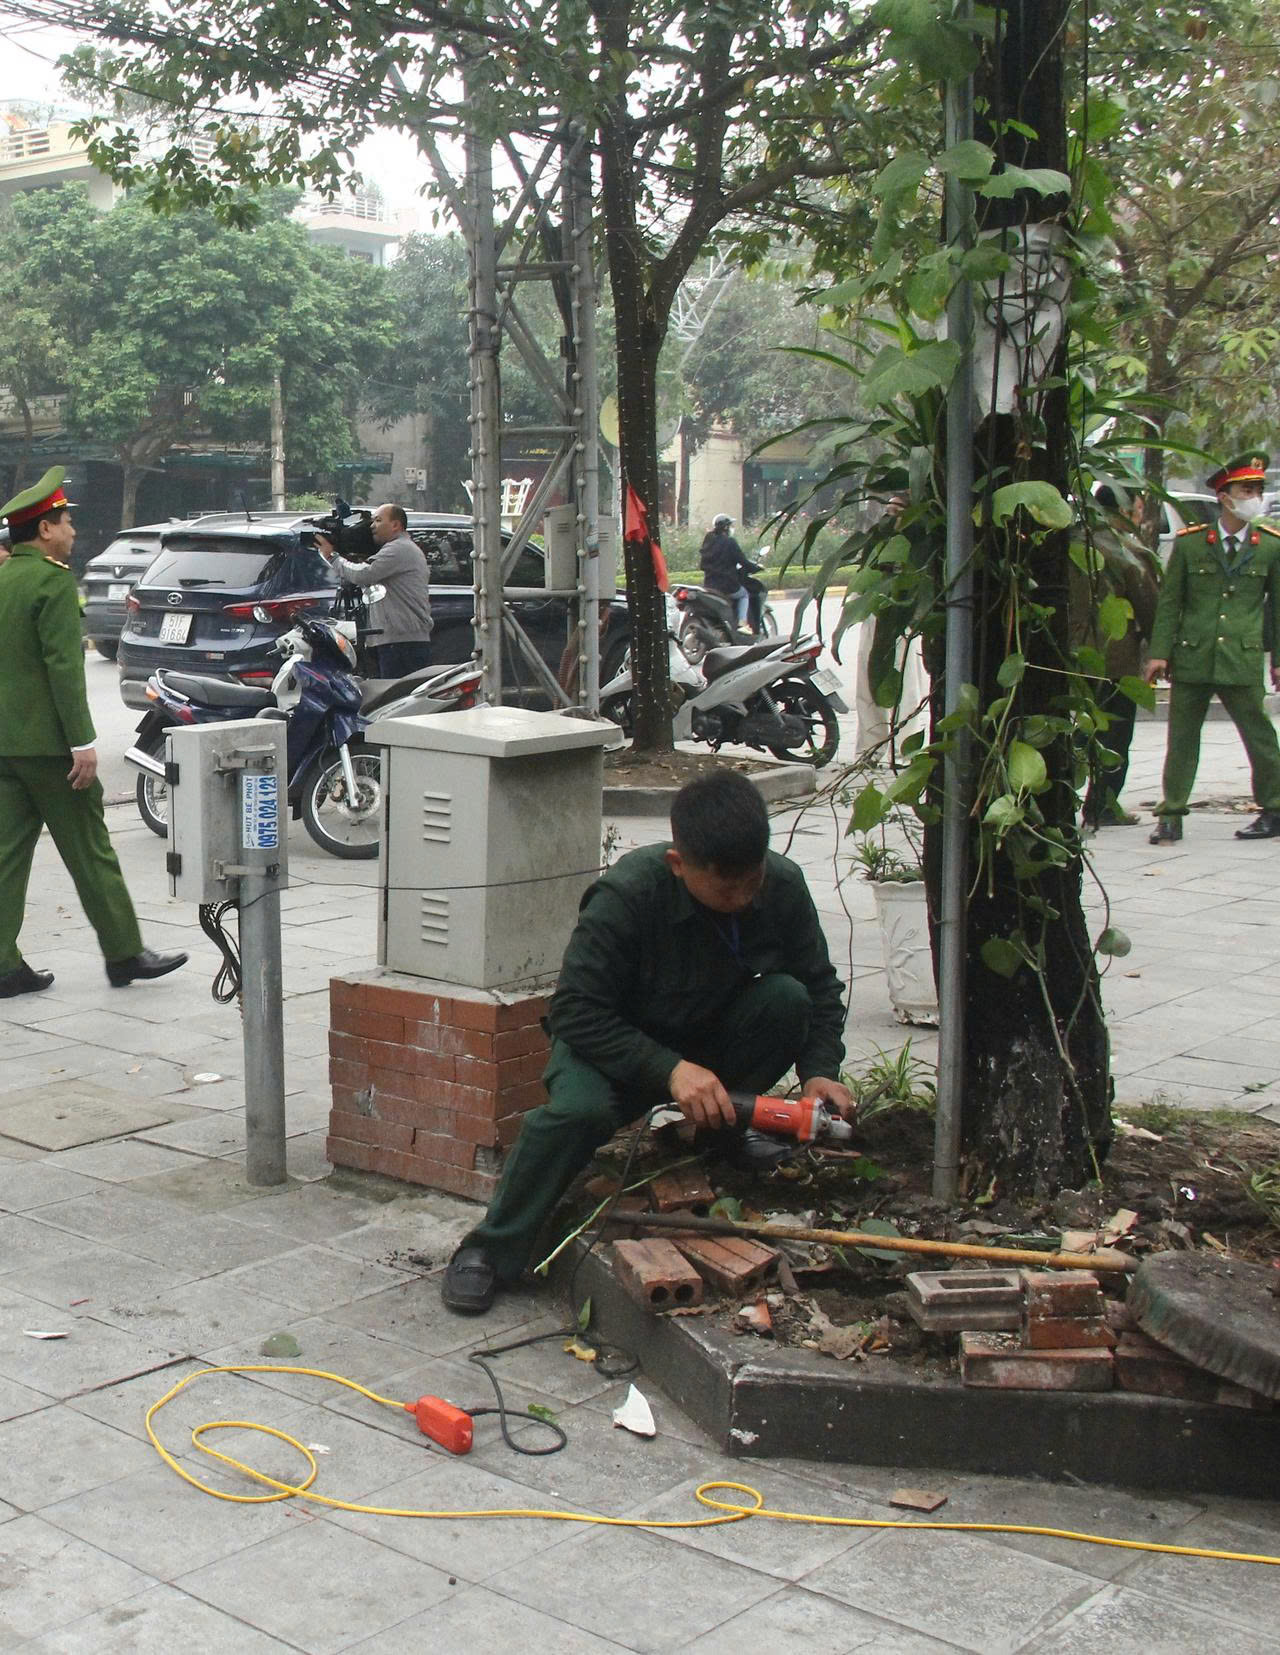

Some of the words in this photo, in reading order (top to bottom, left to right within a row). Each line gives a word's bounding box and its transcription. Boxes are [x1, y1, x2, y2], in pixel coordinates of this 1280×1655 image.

[168, 615, 186, 628] 51F
[258, 776, 277, 796] 123
[258, 798, 277, 819] 024
[257, 821, 277, 848] 0975
